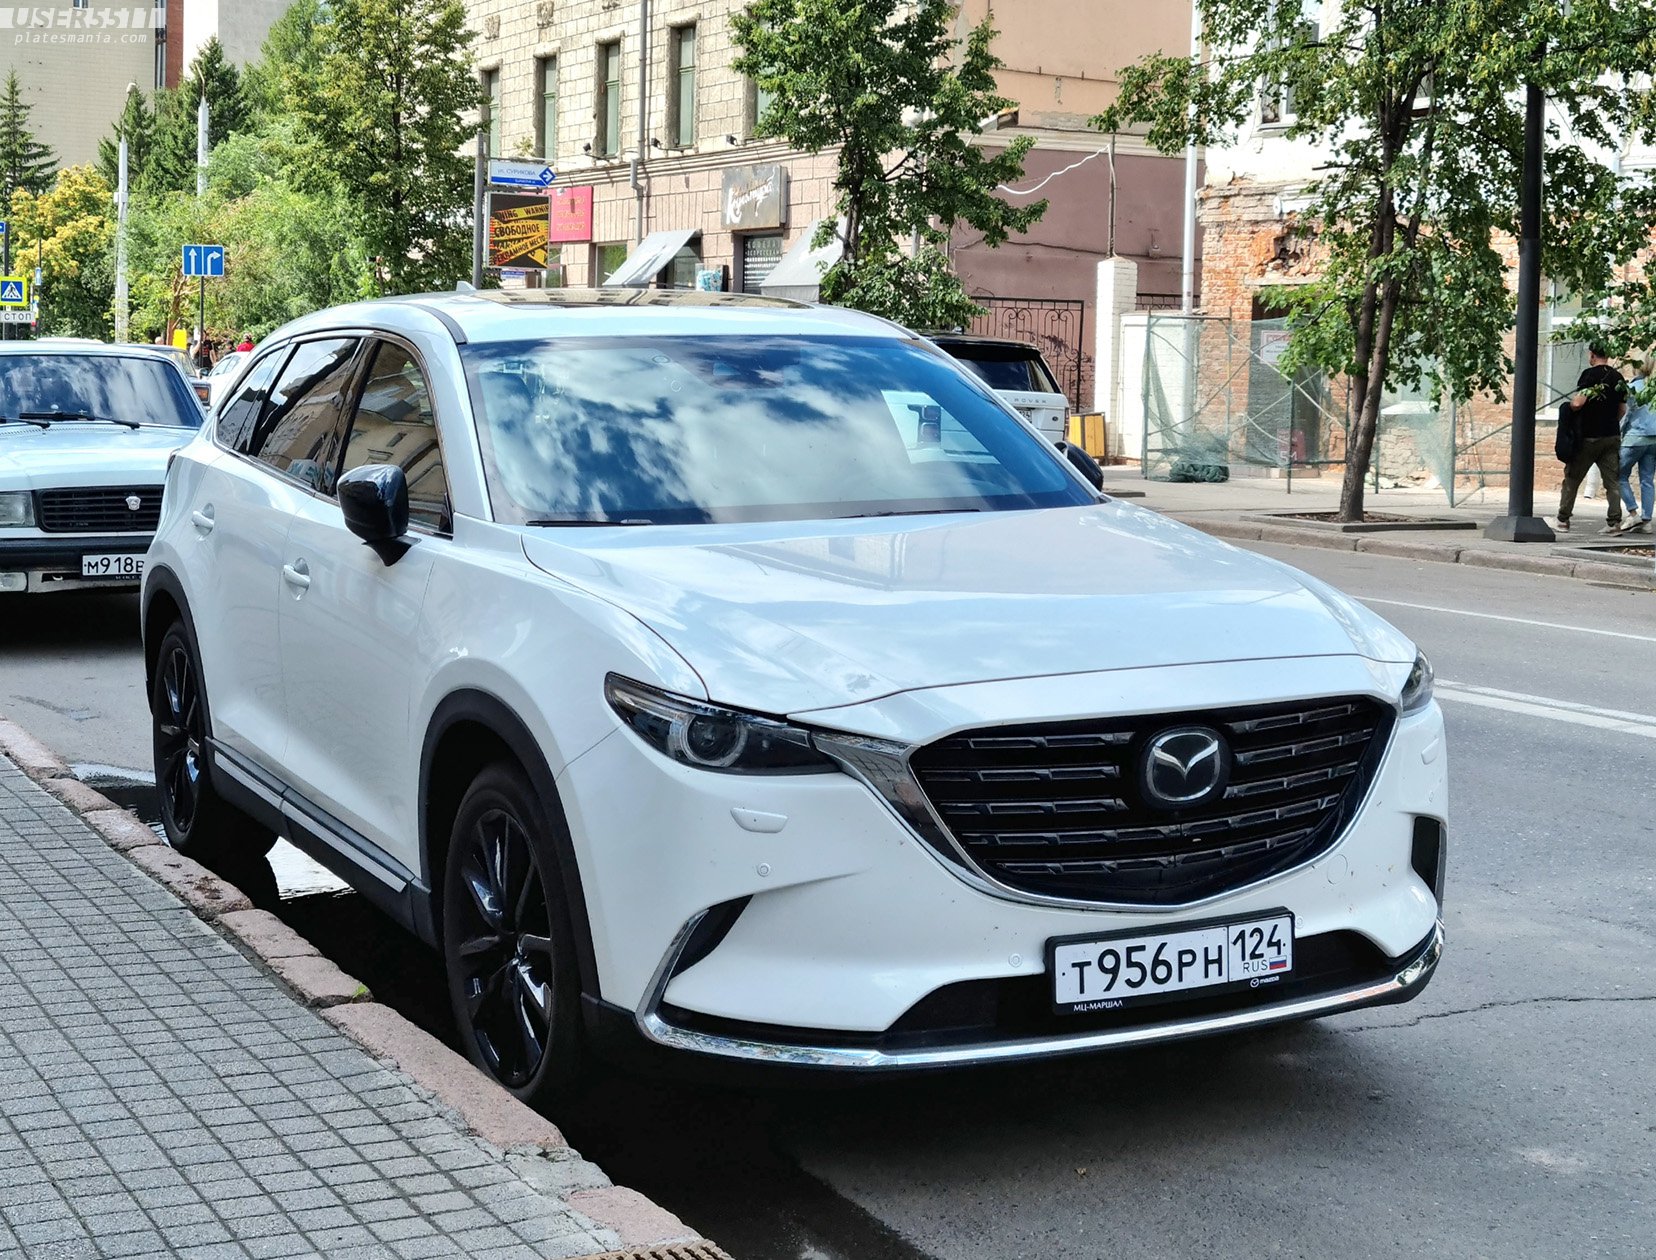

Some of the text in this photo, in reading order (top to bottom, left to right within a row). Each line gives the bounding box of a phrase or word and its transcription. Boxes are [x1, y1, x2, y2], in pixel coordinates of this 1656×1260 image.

[495, 223, 540, 238] СВОБОДНОЕ
[4, 312, 32, 321] СТОП
[1071, 924, 1282, 994] Т956РН 124
[1242, 959, 1268, 973] RUS
[1073, 999, 1124, 1012] МЦ-МАРШАЛ
